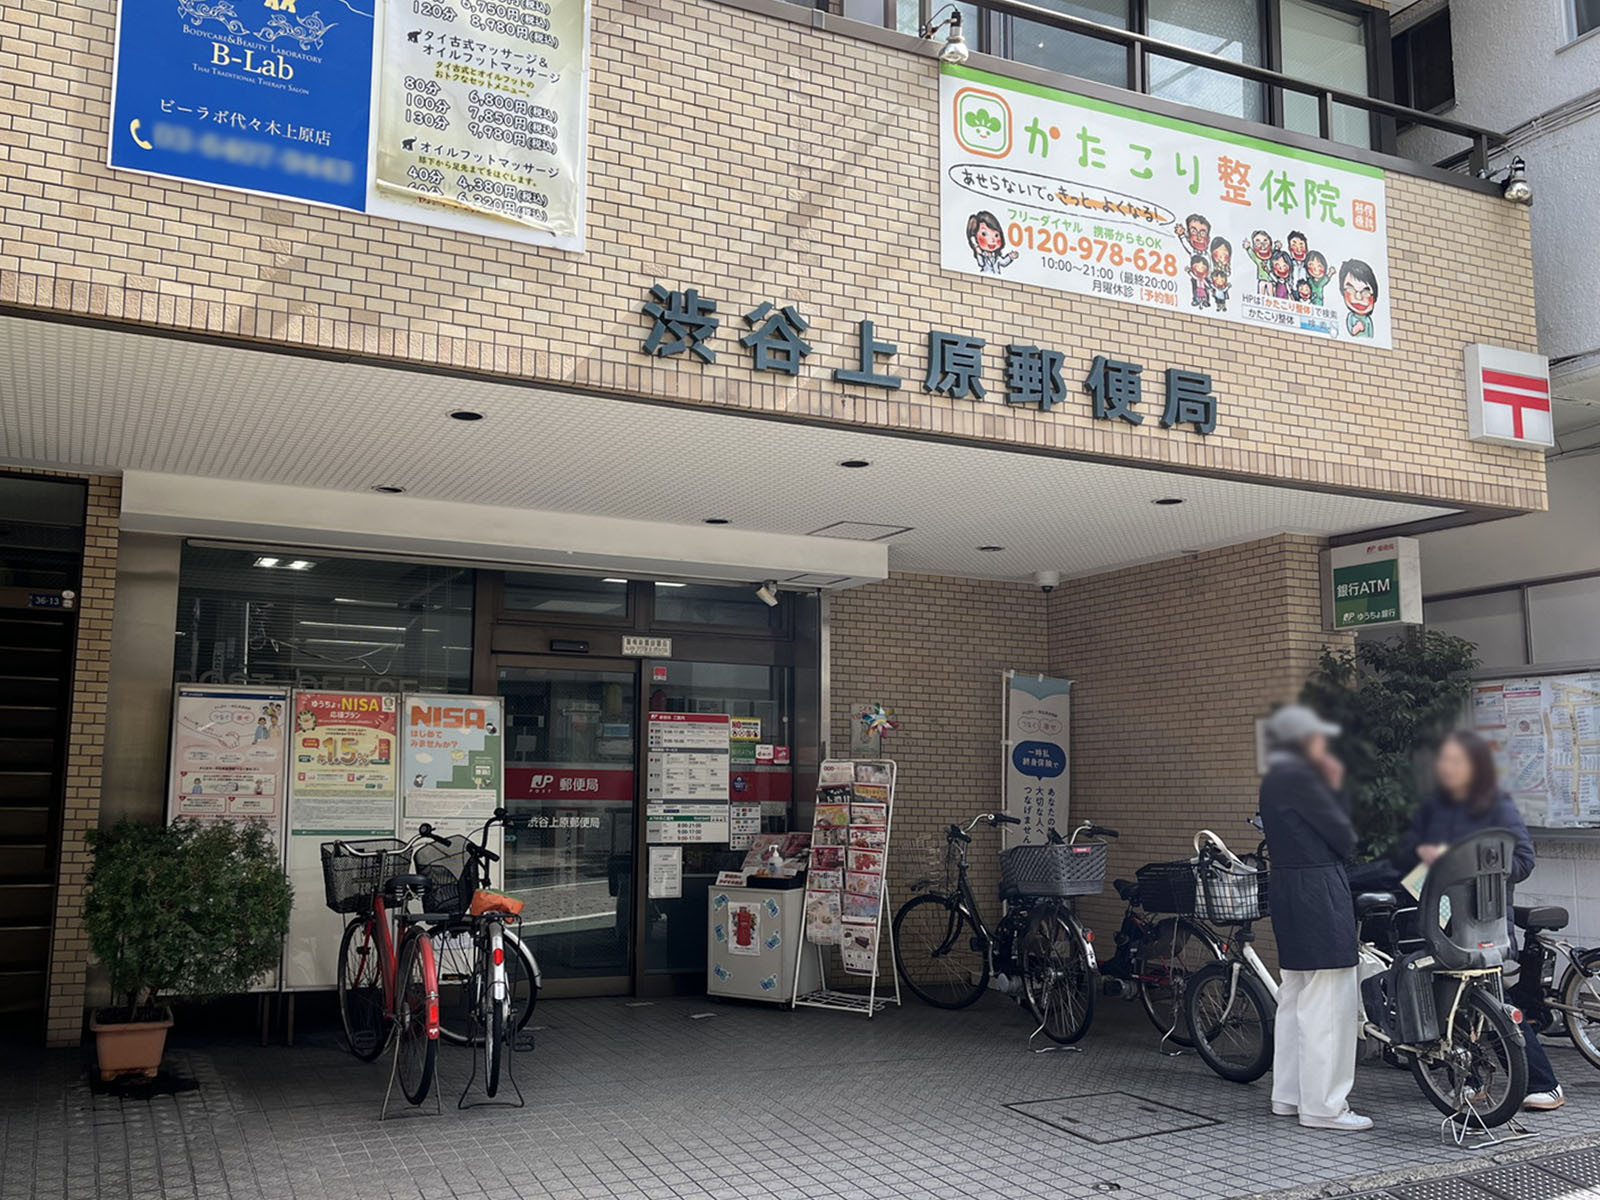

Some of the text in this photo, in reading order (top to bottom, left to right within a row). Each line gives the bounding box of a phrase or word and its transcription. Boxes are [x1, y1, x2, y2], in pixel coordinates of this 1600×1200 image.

[412, 1, 458, 22] 120分
[210, 41, 294, 81] B-Lab
[422, 43, 561, 84] オイルフットマッサージ
[403, 75, 442, 97] 80分
[405, 92, 451, 114] 100分
[160, 98, 332, 147] ビーラボ代々木上原店
[404, 109, 450, 131] 130分
[420, 140, 560, 179] オイルフットマッサージ
[407, 164, 445, 185] 40分
[1024, 116, 1346, 228] かたこり整体院
[1006, 207, 1163, 250] フリーダイヤル 携帯からもOK
[1007, 222, 1179, 278] 0120-978-628
[1092, 279, 1135, 298] 月曜休診
[641, 283, 1219, 436] 渋谷上原郵便局
[1336, 578, 1391, 598] 銀行ATM
[1357, 608, 1396, 621] ゆうちょ銀行
[341, 697, 379, 712] NISA
[410, 705, 485, 730] NISA
[410, 730, 443, 739] はじめて
[559, 777, 599, 792] 郵便局
[1035, 786, 1045, 835] 大切な人へ
[527, 816, 600, 829] 渋谷上原郵便局
